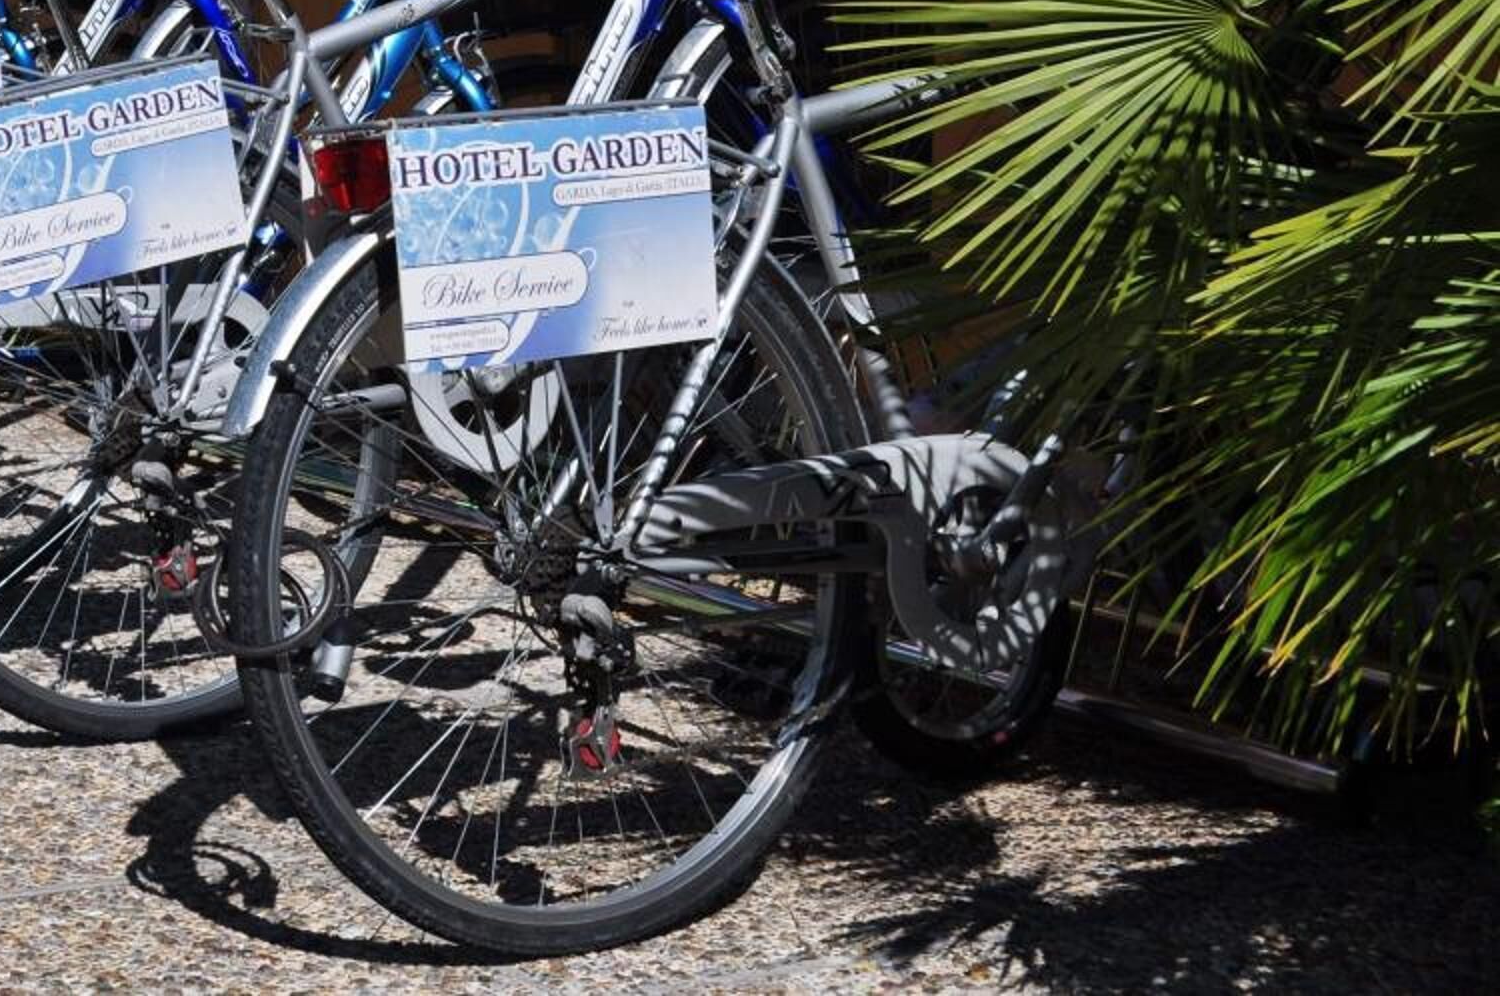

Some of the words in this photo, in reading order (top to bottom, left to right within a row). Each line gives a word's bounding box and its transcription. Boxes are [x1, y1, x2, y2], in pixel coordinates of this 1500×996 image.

[87, 79, 222, 132] GARDEN
[399, 146, 543, 189] HOTEL
[552, 131, 707, 175] GARDEN
[47, 210, 116, 240] Service
[422, 273, 487, 308] Bike
[493, 263, 575, 300] Service
[633, 317, 653, 335] like
